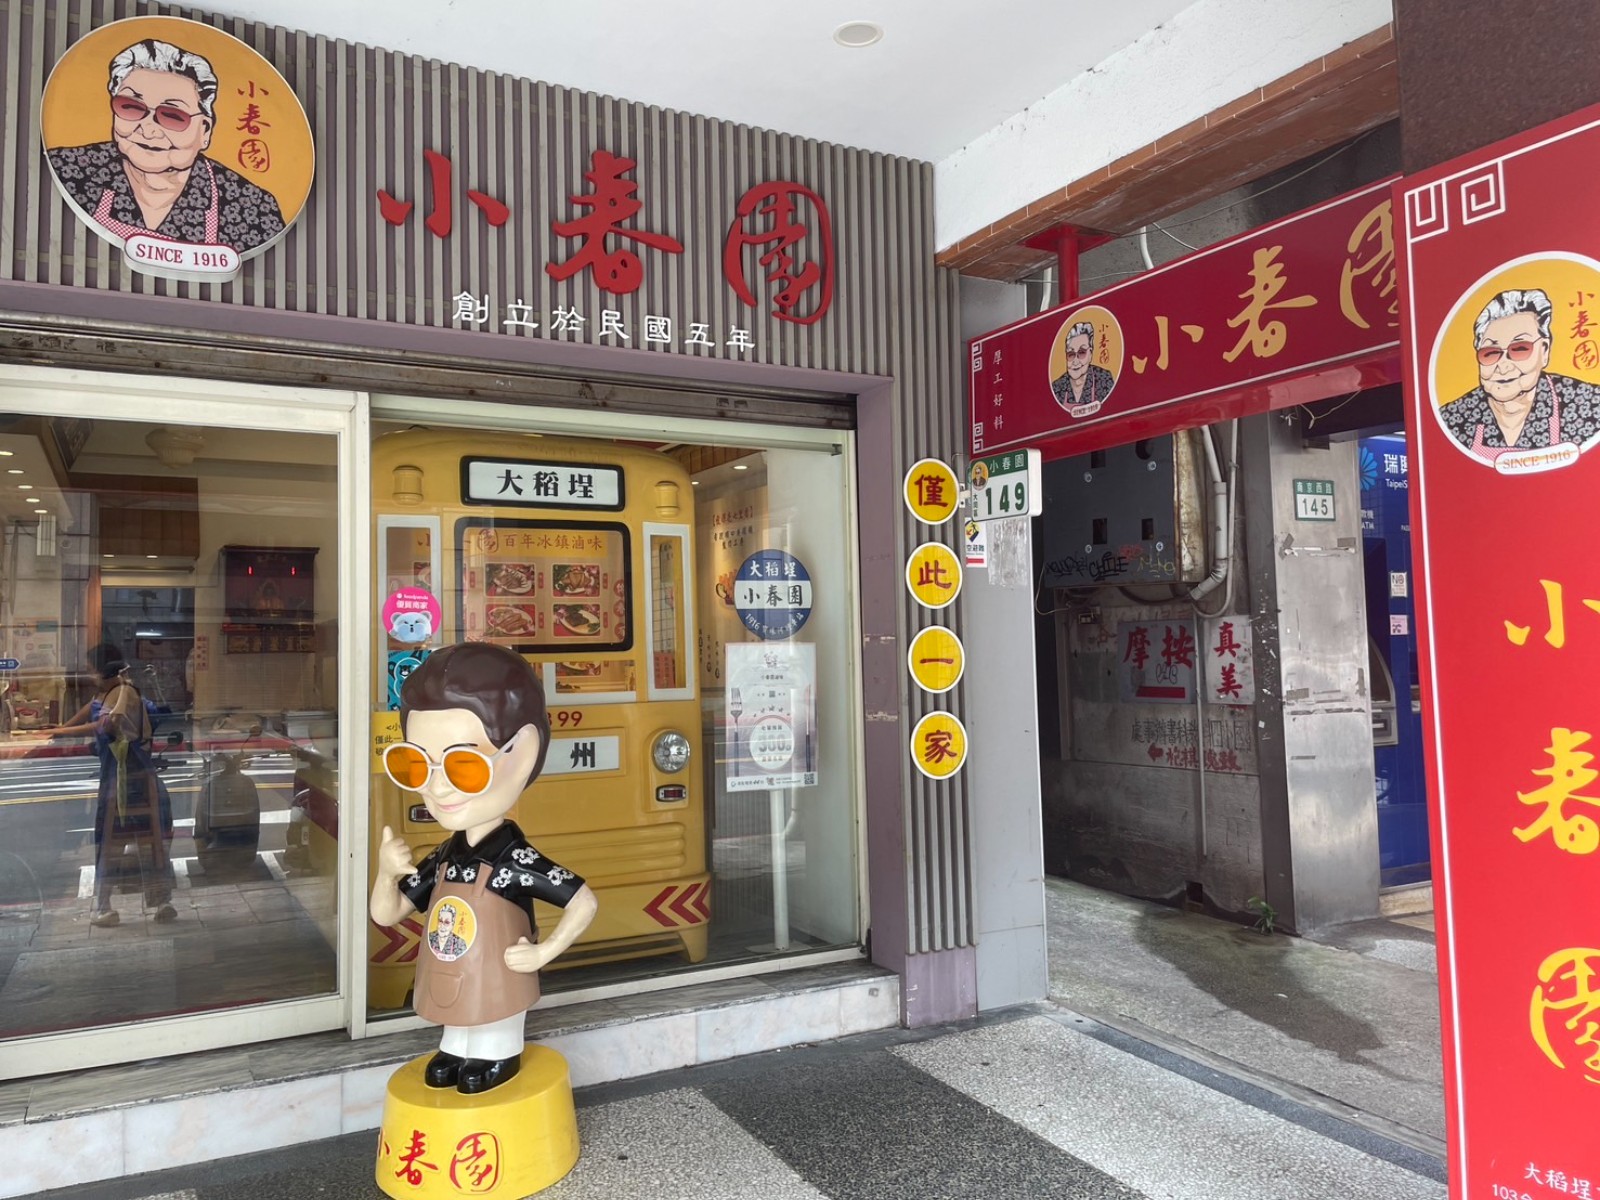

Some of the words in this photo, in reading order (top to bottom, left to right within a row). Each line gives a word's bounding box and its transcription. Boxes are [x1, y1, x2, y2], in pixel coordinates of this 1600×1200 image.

[236, 80, 271, 173] 小春園
[377, 149, 834, 326] 小春園
[136, 243, 183, 265] SINCE
[193, 251, 229, 268] 1916
[453, 291, 756, 352] 創立於民國五年
[1569, 291, 1599, 370] 小春園
[1099, 323, 1110, 364] 小春園
[989, 453, 1025, 474] 小春園
[1502, 455, 1540, 469] SINCE
[1545, 449, 1571, 465] 1916
[496, 468, 595, 499] 大稻埕
[1296, 481, 1332, 494] 南京西路
[985, 482, 1026, 515] 149
[1302, 498, 1329, 516] 145
[503, 533, 603, 551] 百年冰鎮滷味
[750, 560, 797, 578] 大稻埕
[744, 584, 803, 607] 小春園
[745, 613, 761, 630] 1916
[914, 474, 957, 764] 僅此一家
[1213, 621, 1243, 699] 真美
[570, 741, 596, 769] 州
